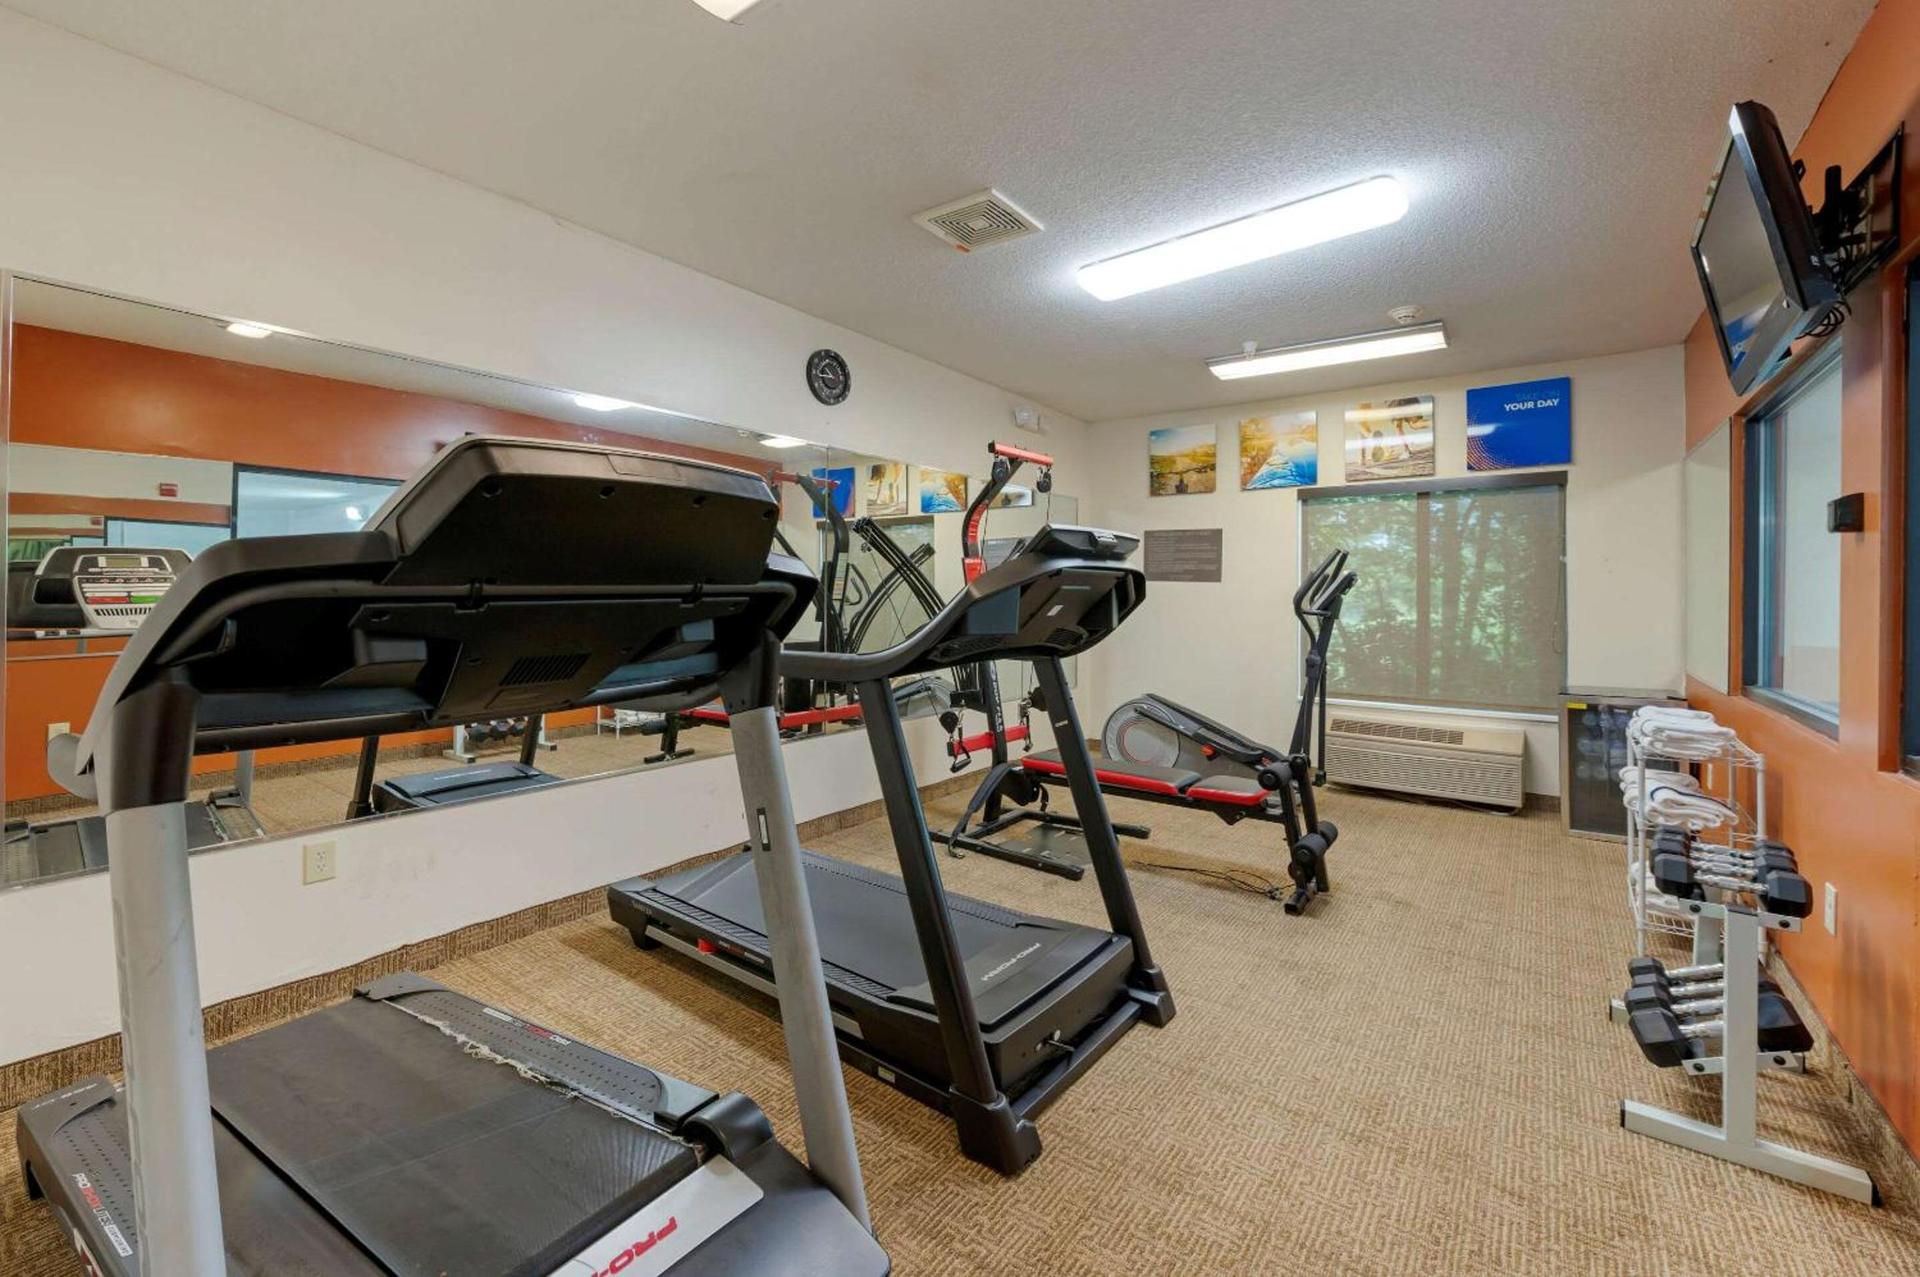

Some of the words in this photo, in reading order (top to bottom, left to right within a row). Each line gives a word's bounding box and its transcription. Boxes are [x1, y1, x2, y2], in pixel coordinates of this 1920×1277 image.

[1504, 401, 1534, 411] YOUR
[1537, 398, 1559, 407] DAY
[591, 1216, 678, 1277] PRO-
